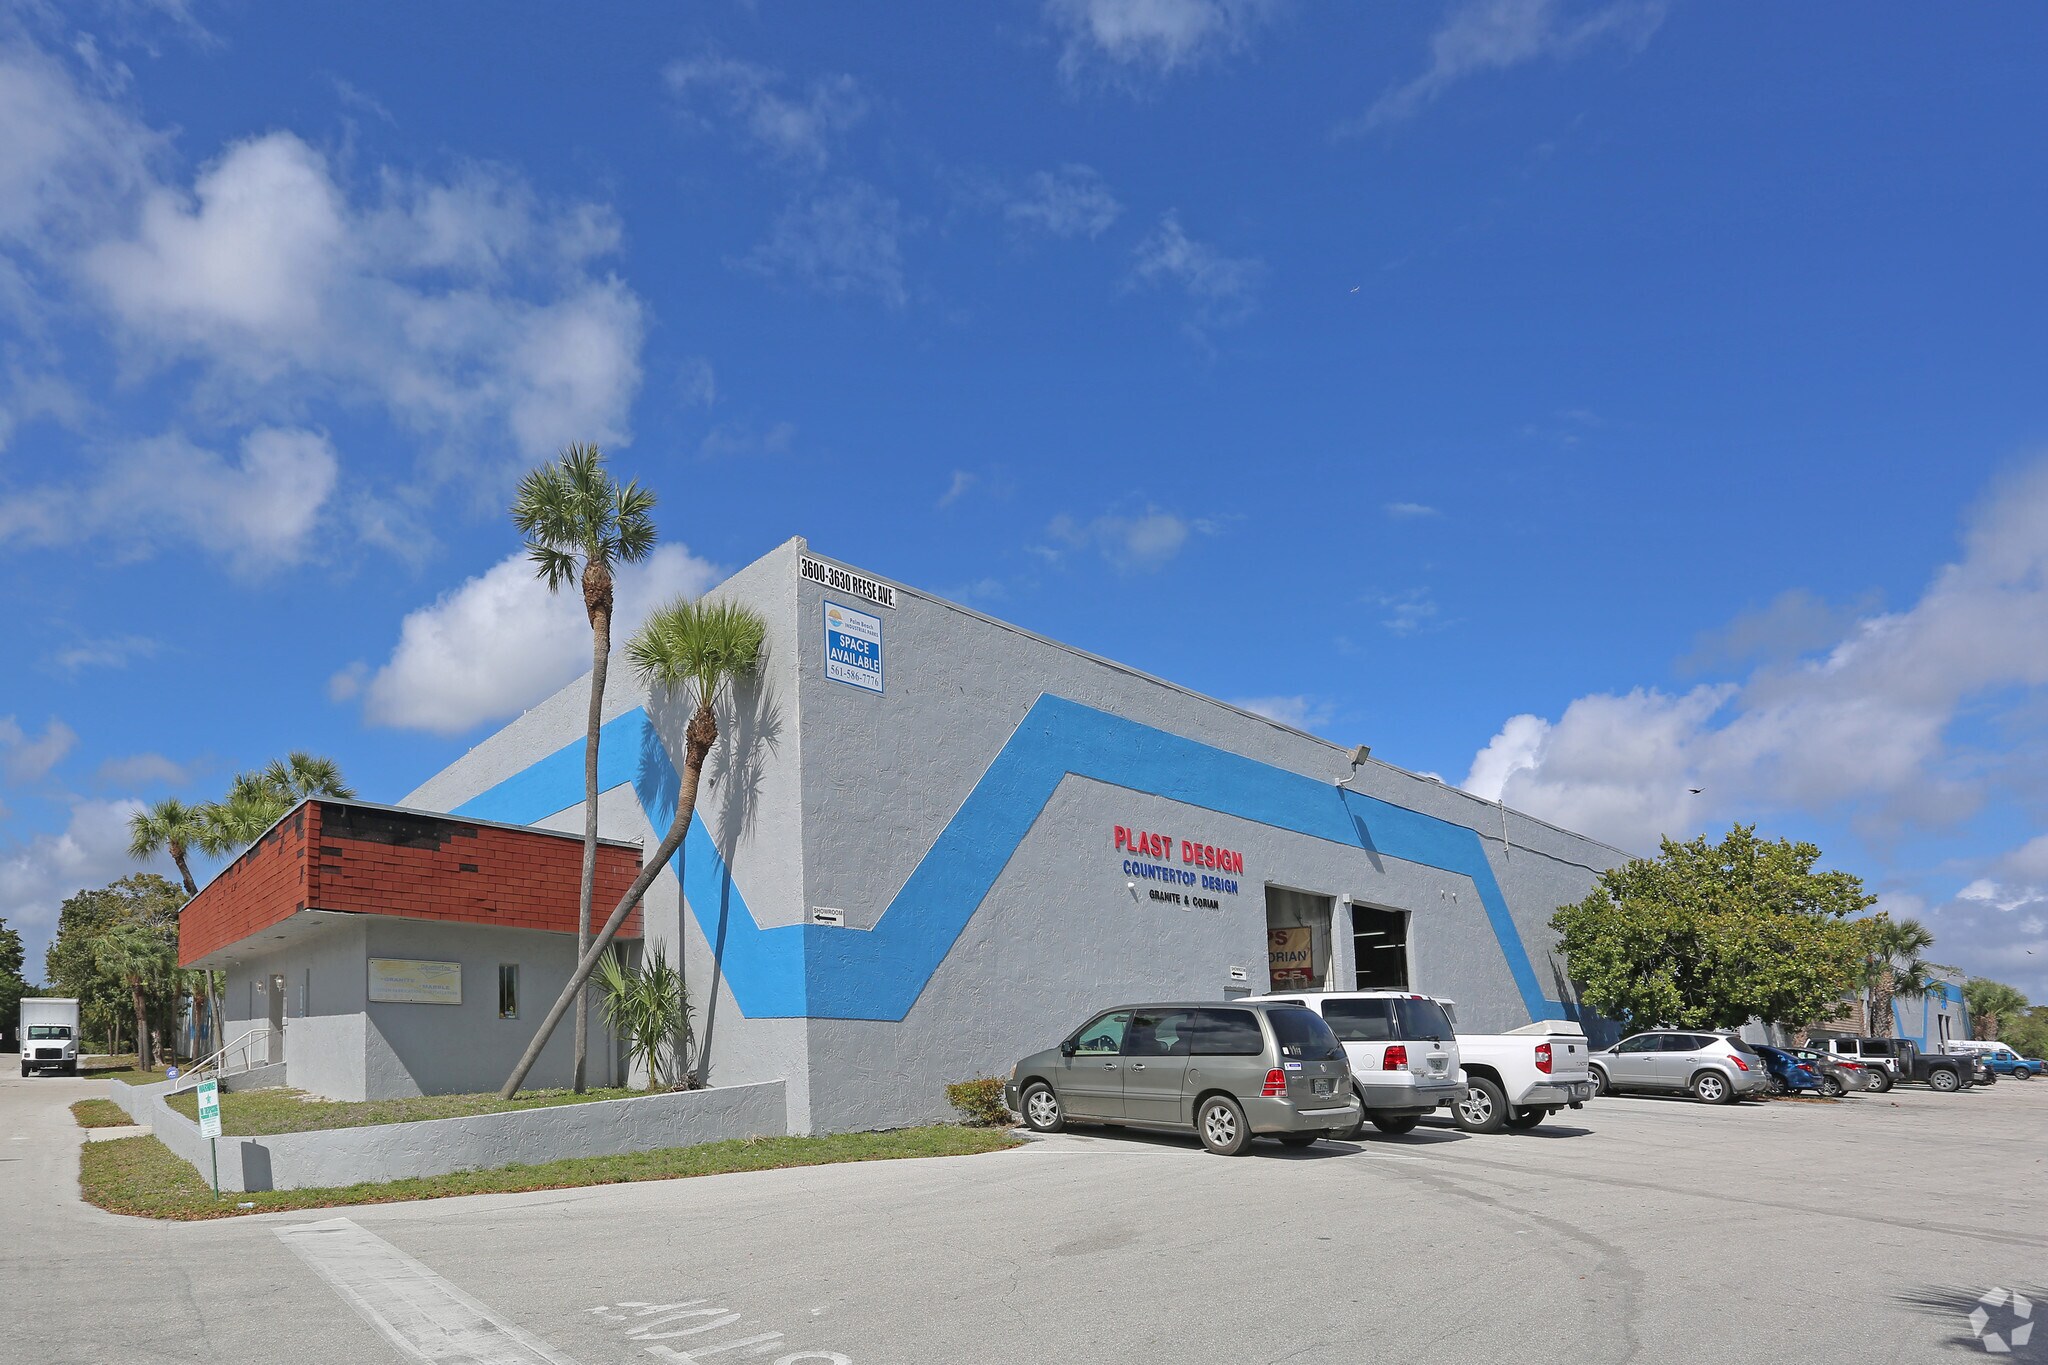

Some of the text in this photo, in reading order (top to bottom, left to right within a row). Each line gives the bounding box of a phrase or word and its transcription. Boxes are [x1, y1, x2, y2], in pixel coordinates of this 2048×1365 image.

[801, 558, 895, 607] 3600-3630 REESE AVE.
[844, 623, 879, 638] INDUSTRIAL PARKS
[849, 617, 874, 630] Palm Beach
[839, 634, 870, 655] SPACE
[830, 647, 879, 672] AVAILABLE
[830, 664, 879, 687] 561-586-7776
[1113, 824, 1244, 875] PLAST DESIGN
[1122, 859, 1239, 896] COUNTERTOP DESIGN
[1149, 889, 1219, 910] GRANITE & CORIAN
